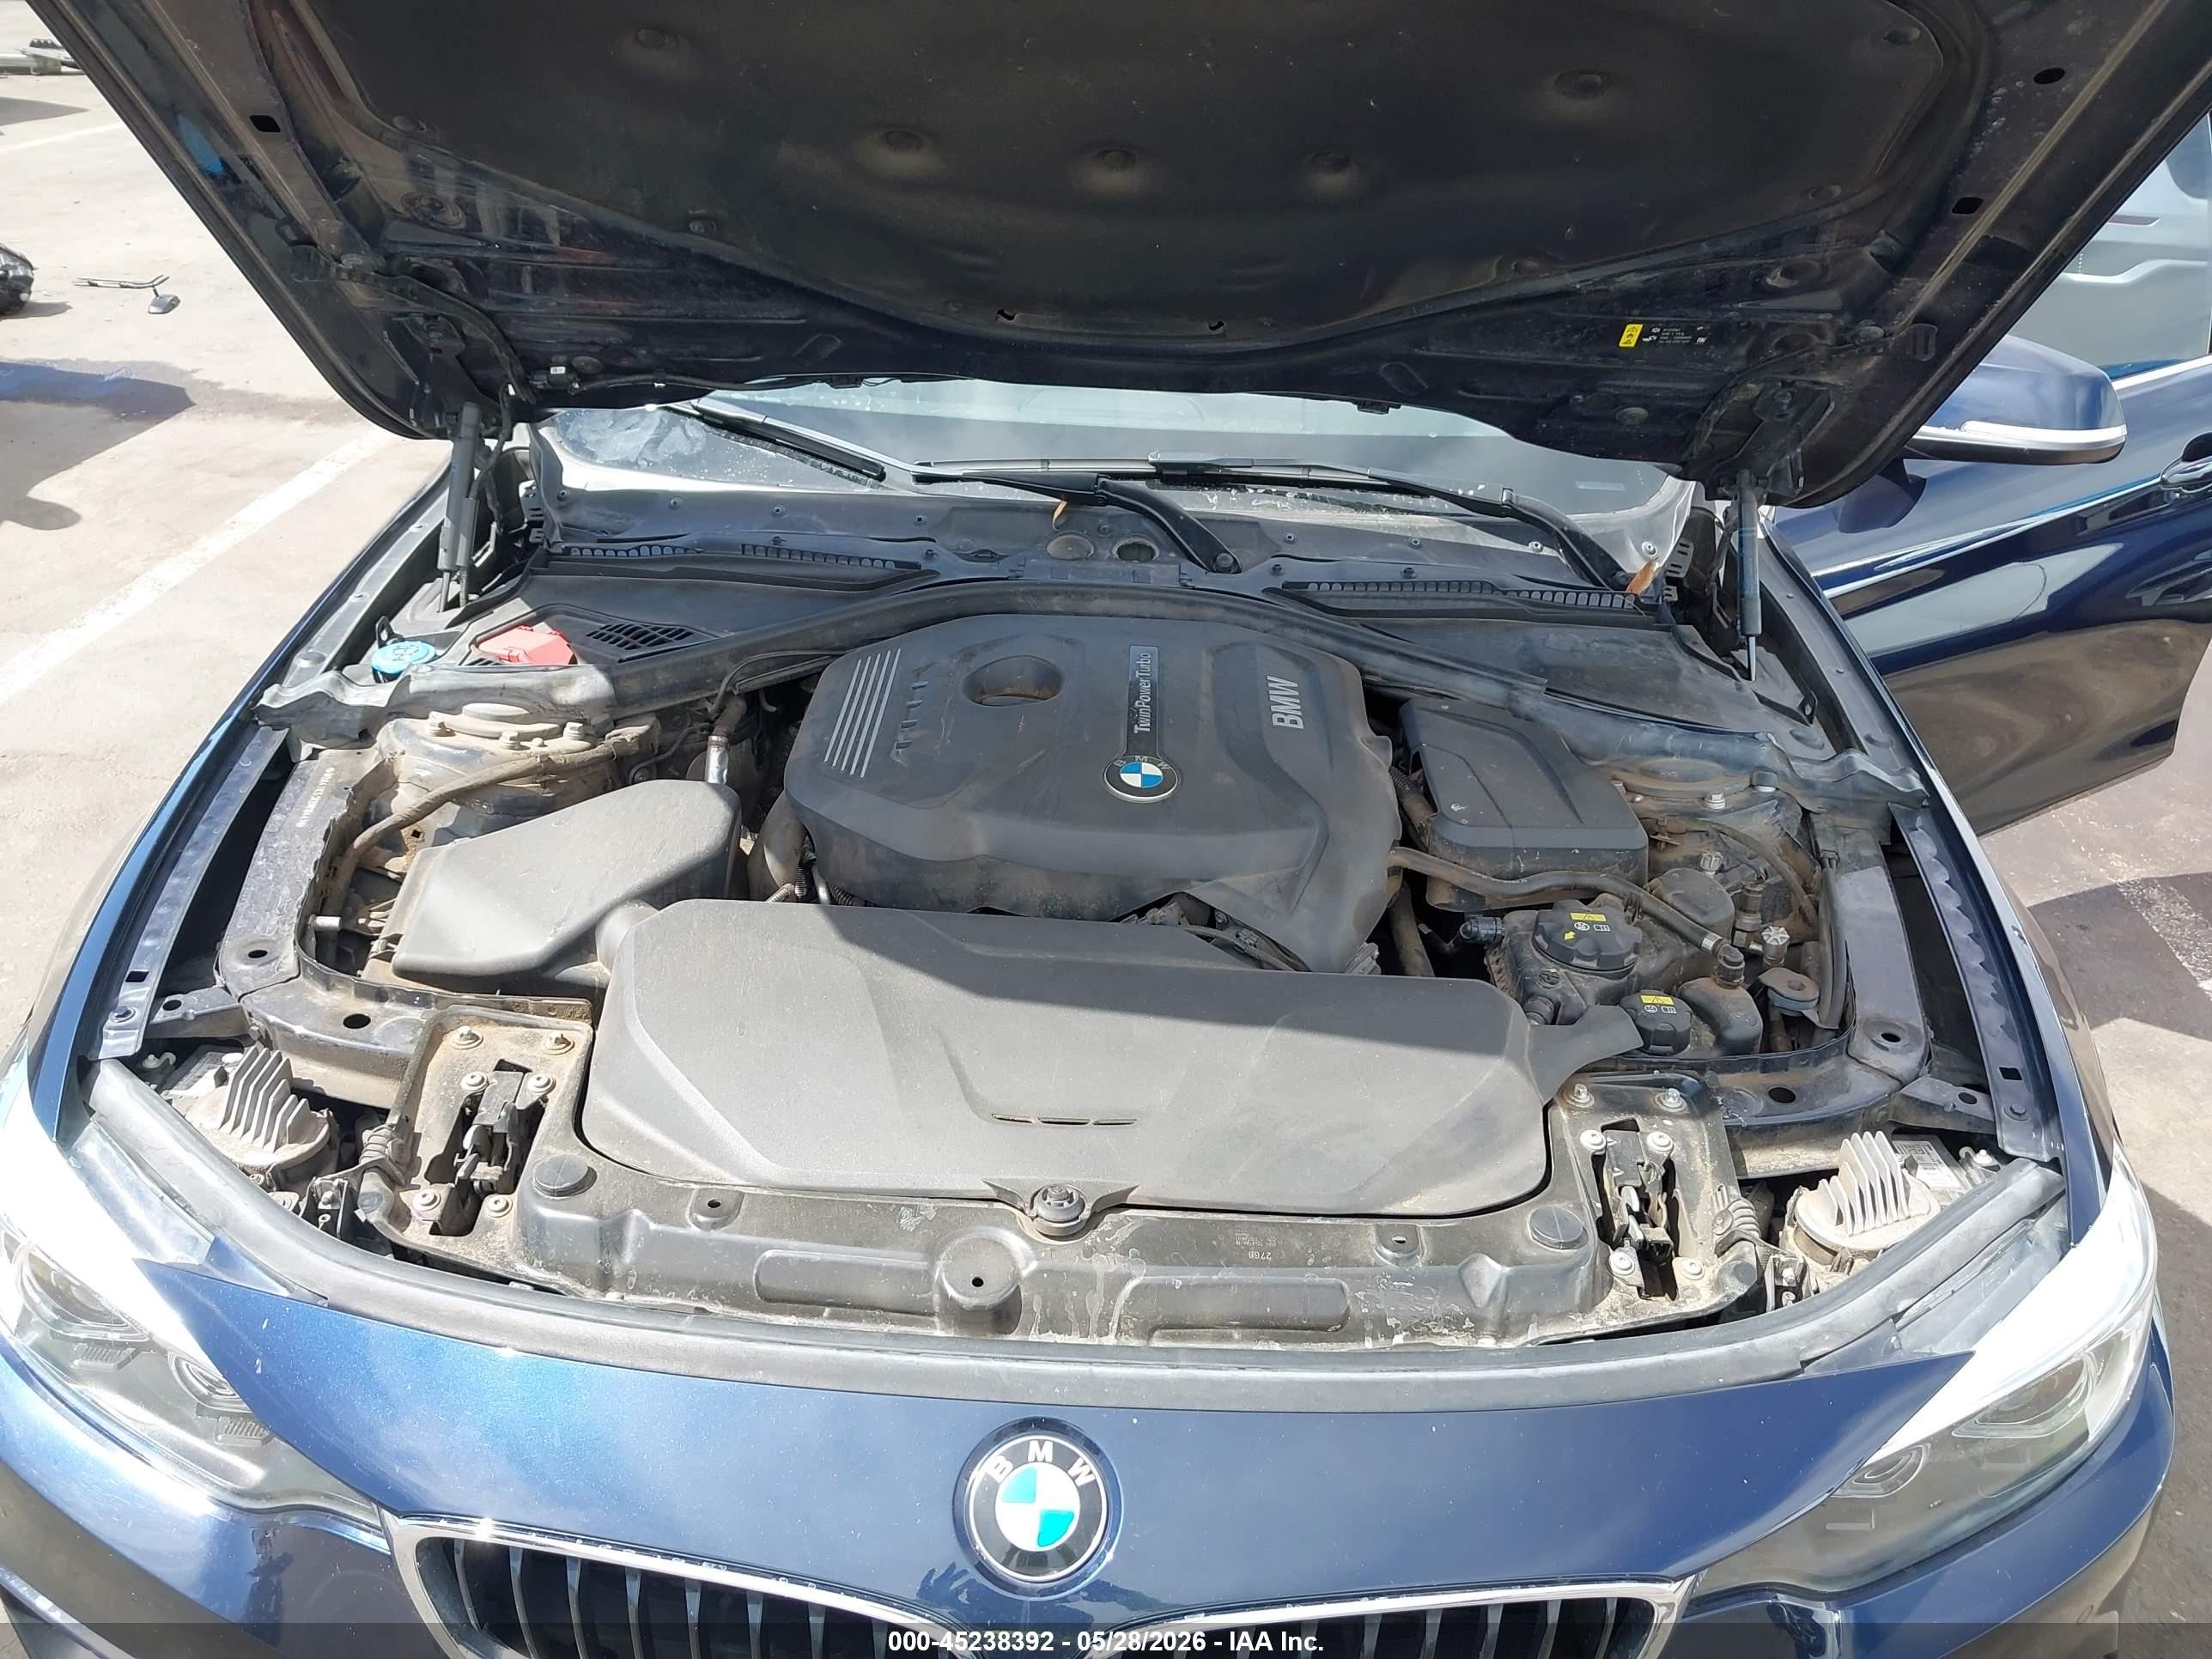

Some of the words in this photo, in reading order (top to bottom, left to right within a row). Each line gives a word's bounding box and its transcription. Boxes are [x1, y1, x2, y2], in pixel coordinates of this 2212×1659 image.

[1267, 675, 1304, 730] BMW
[1114, 756, 1171, 769] BMW
[986, 1440, 1097, 1487] BMW
